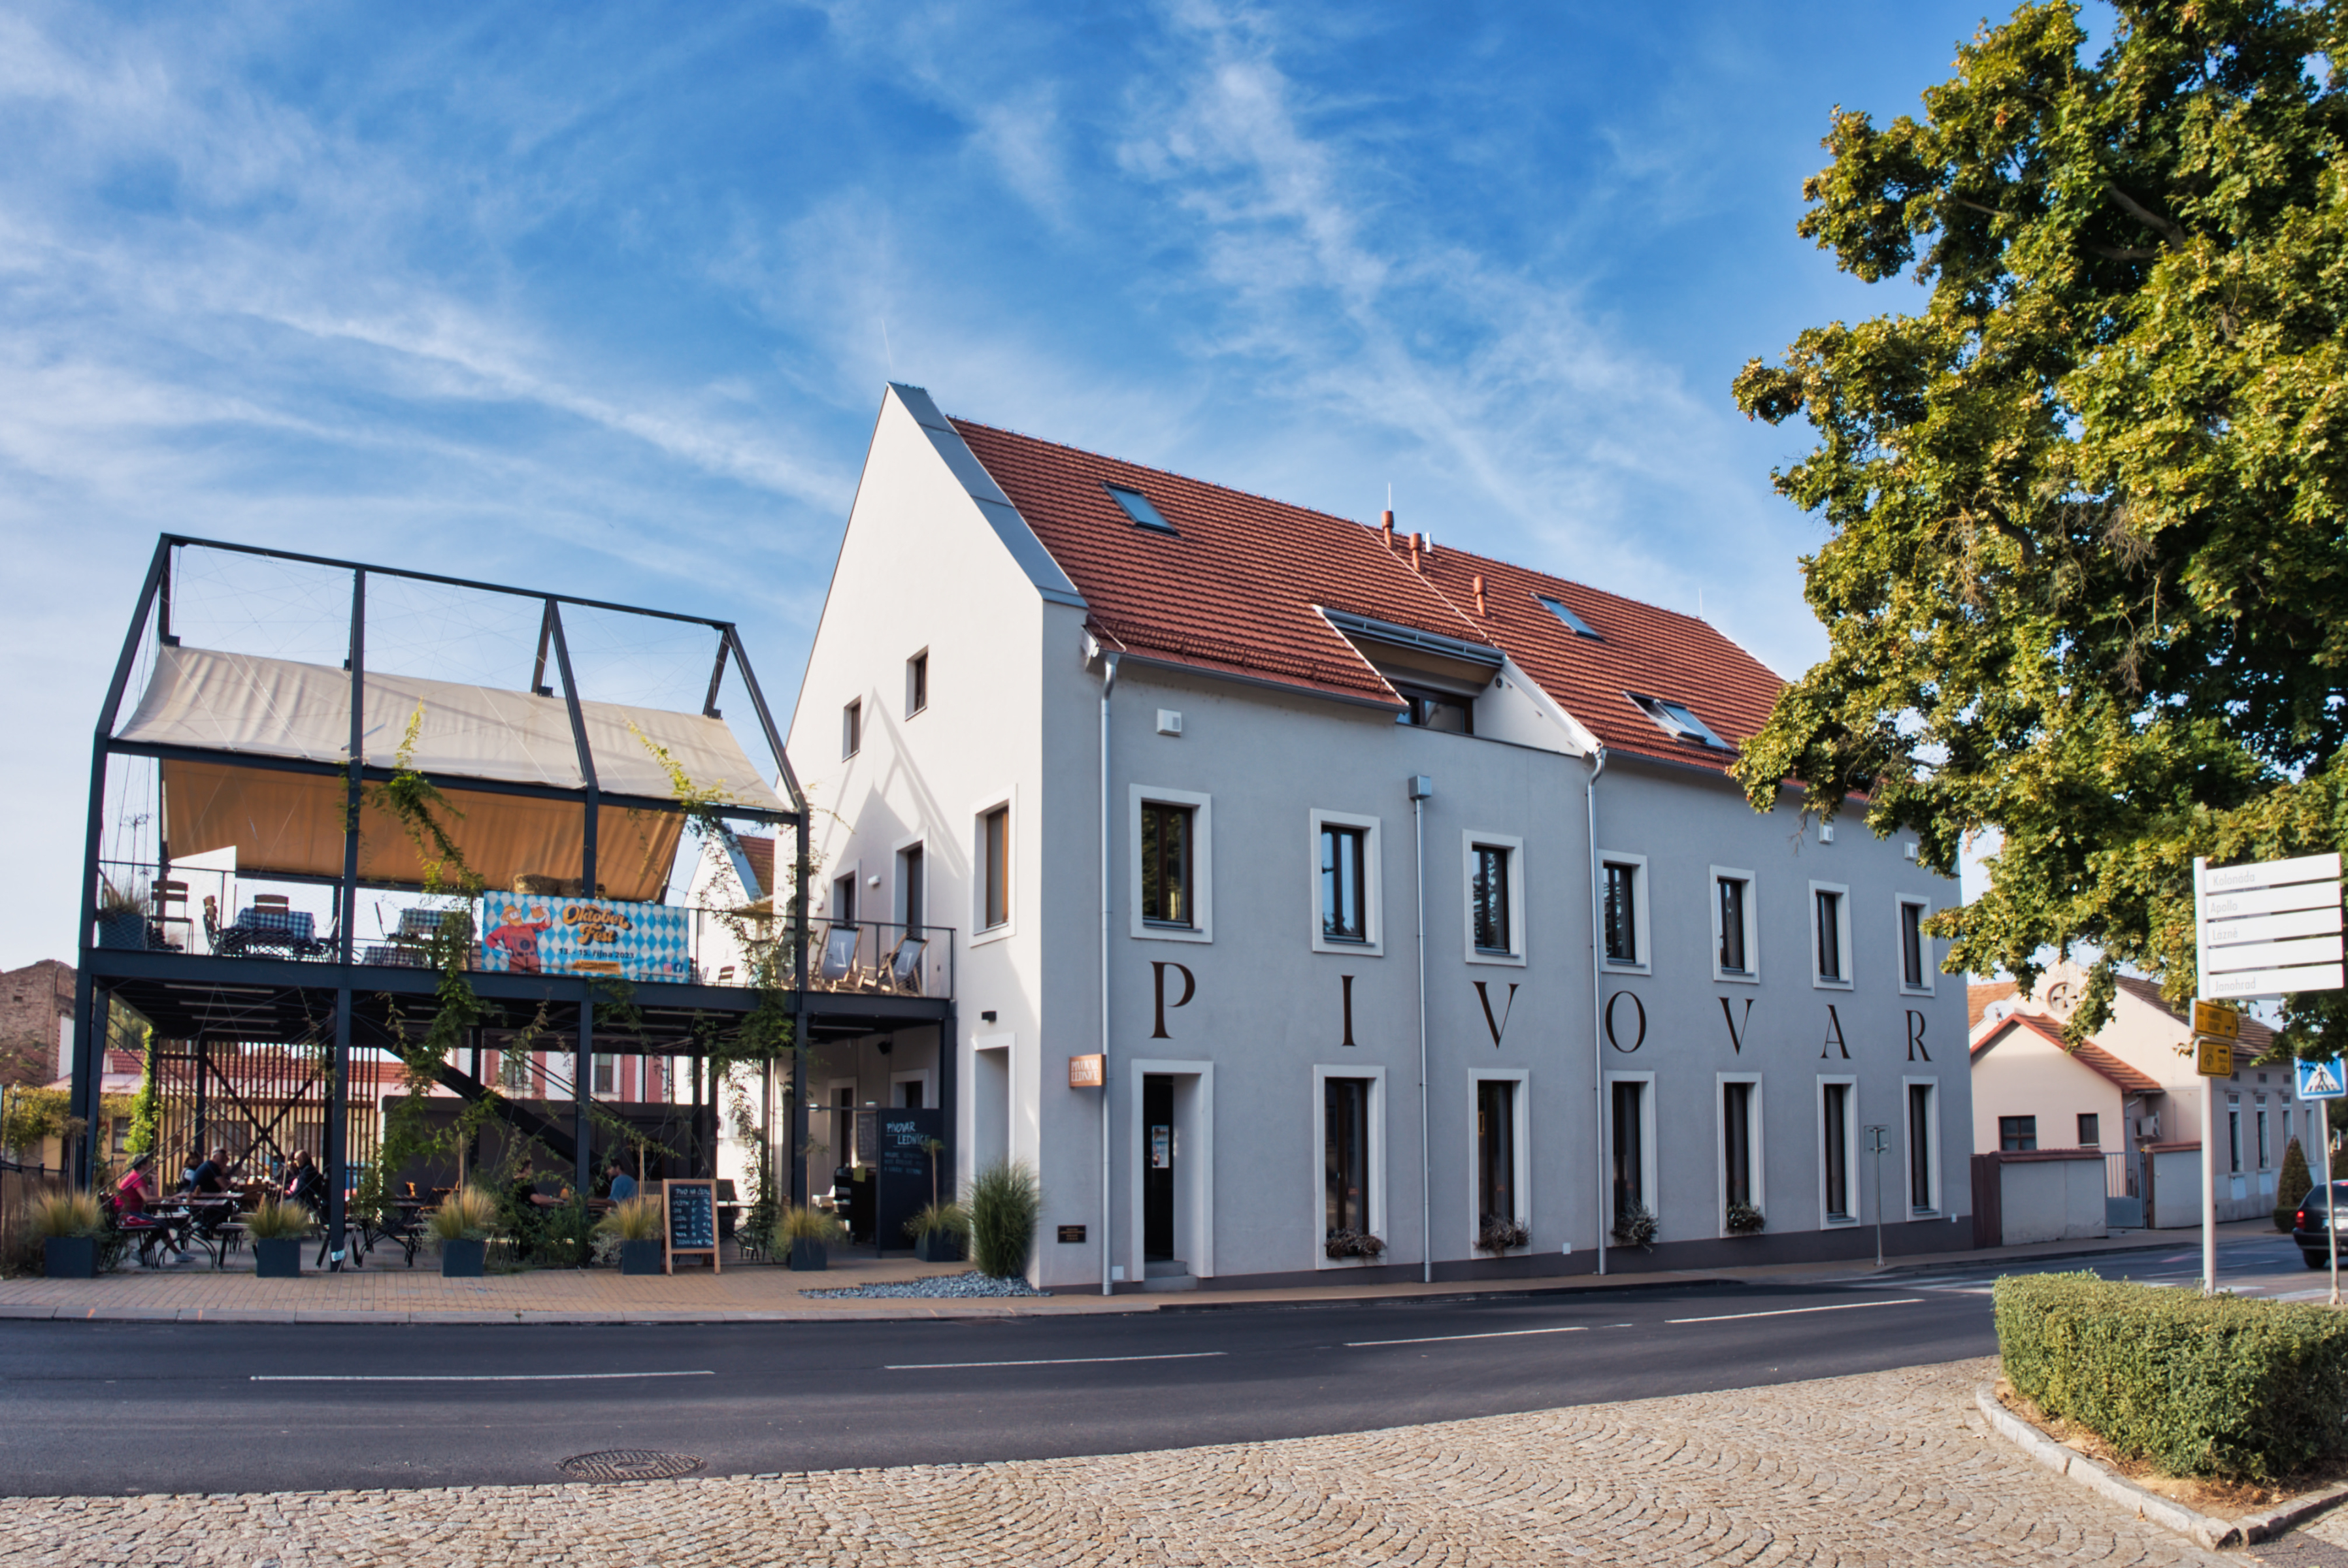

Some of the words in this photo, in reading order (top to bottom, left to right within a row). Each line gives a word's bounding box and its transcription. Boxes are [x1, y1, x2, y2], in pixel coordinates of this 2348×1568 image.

[2213, 870, 2256, 887] Kolonáda
[2210, 898, 2238, 915] Apollo
[563, 904, 633, 930] Oktober
[577, 923, 618, 945] Fest
[2212, 927, 2238, 941] Lázně
[2214, 977, 2257, 992] Janohrad
[1149, 960, 1932, 1062] PIVOVAR
[1071, 1059, 1099, 1071] PIVOVAR
[1071, 1070, 1099, 1082] LEDNICE
